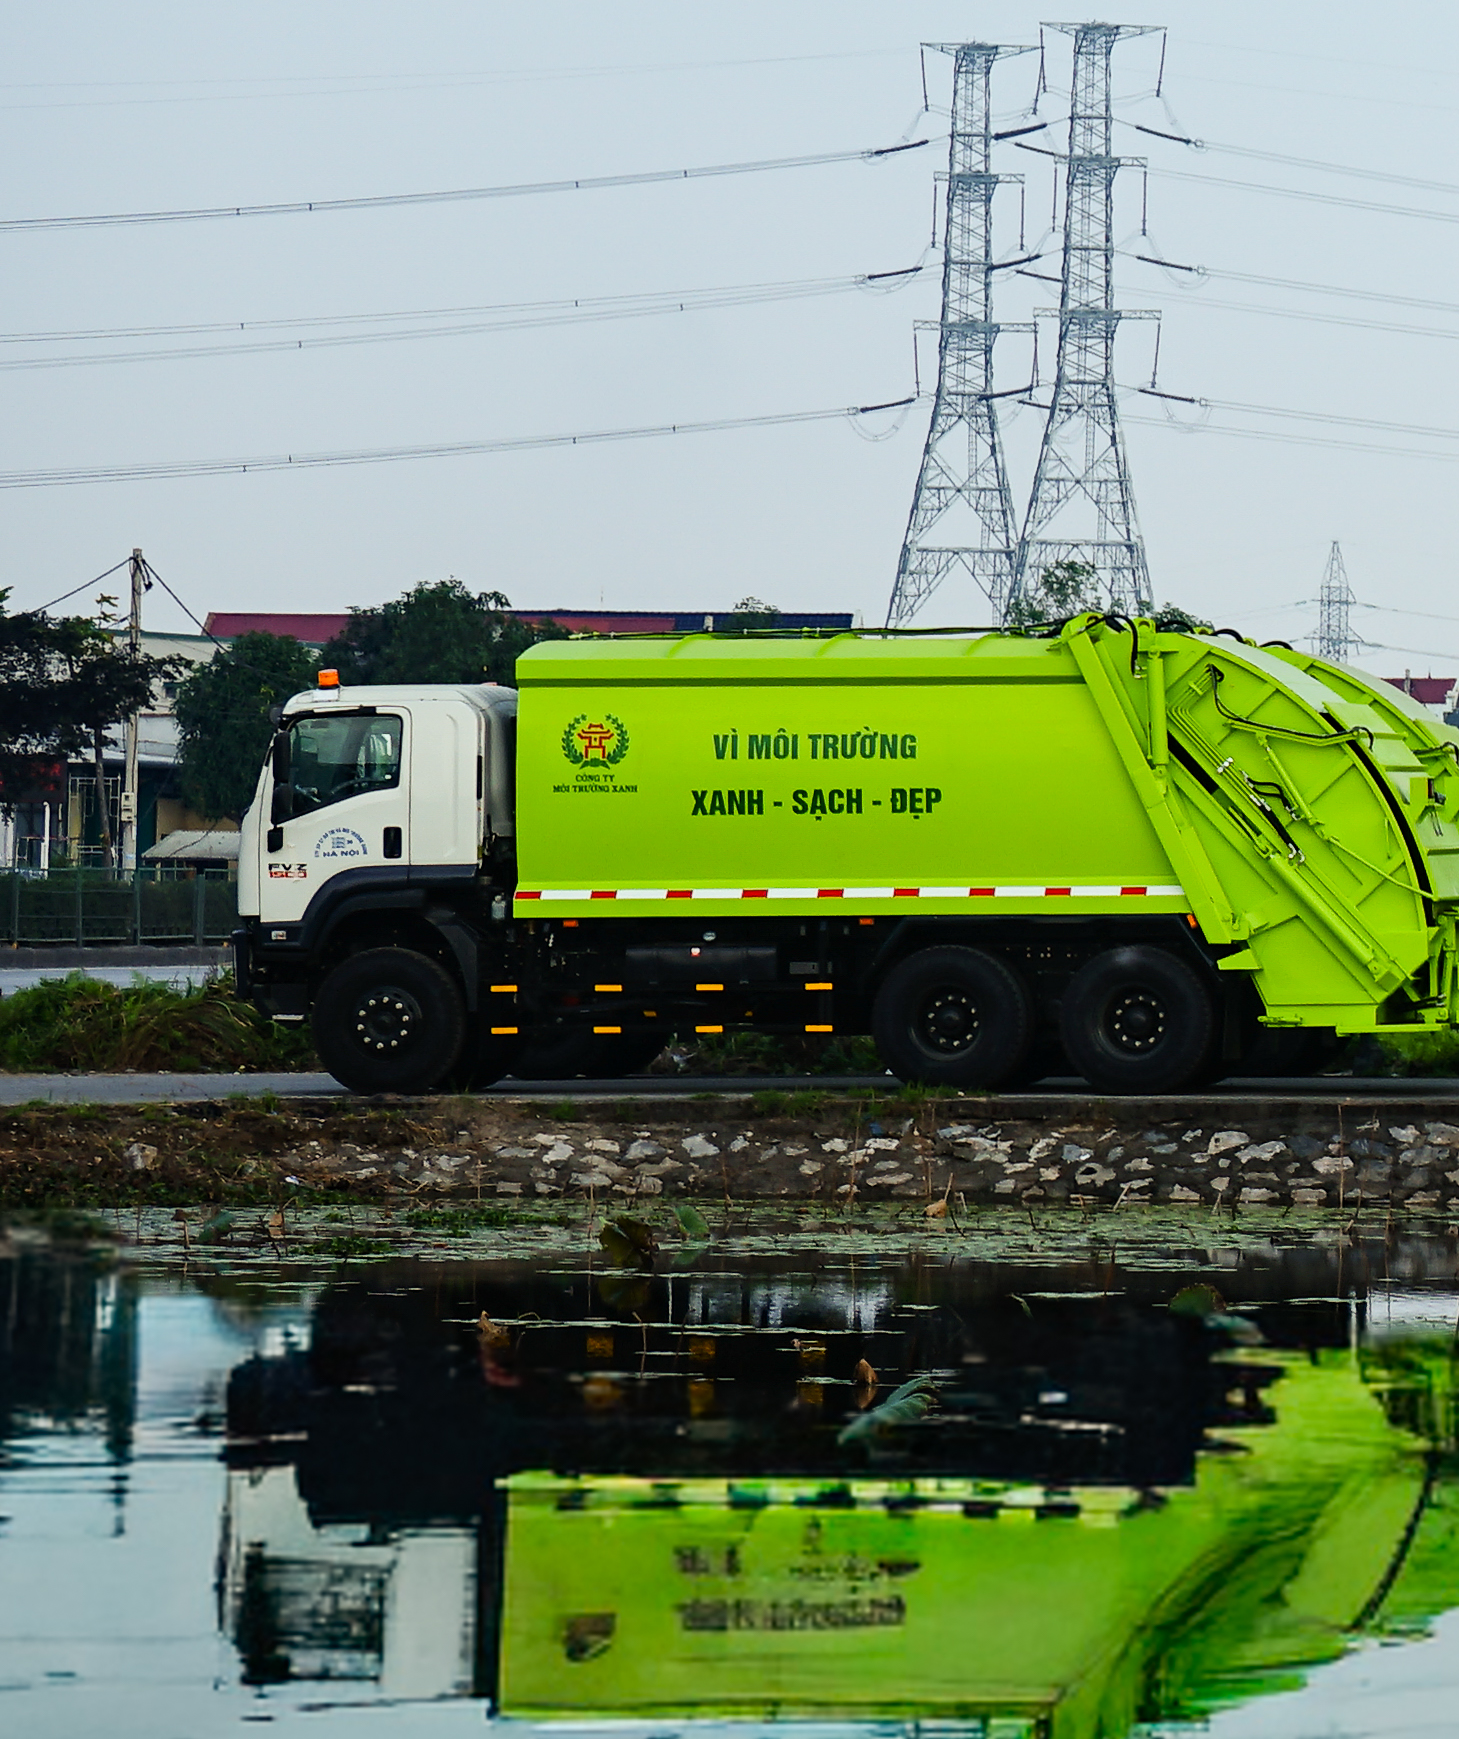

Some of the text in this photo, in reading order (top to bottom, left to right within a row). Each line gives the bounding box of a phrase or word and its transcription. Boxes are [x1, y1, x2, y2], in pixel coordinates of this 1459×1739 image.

[713, 726, 916, 760] VÌ MÔI TRƯỜNG
[603, 774, 615, 782] TY
[612, 784, 638, 793] XANH
[691, 790, 764, 816] XANH
[792, 789, 862, 821] SẠCH
[890, 788, 941, 819] ĐẸP
